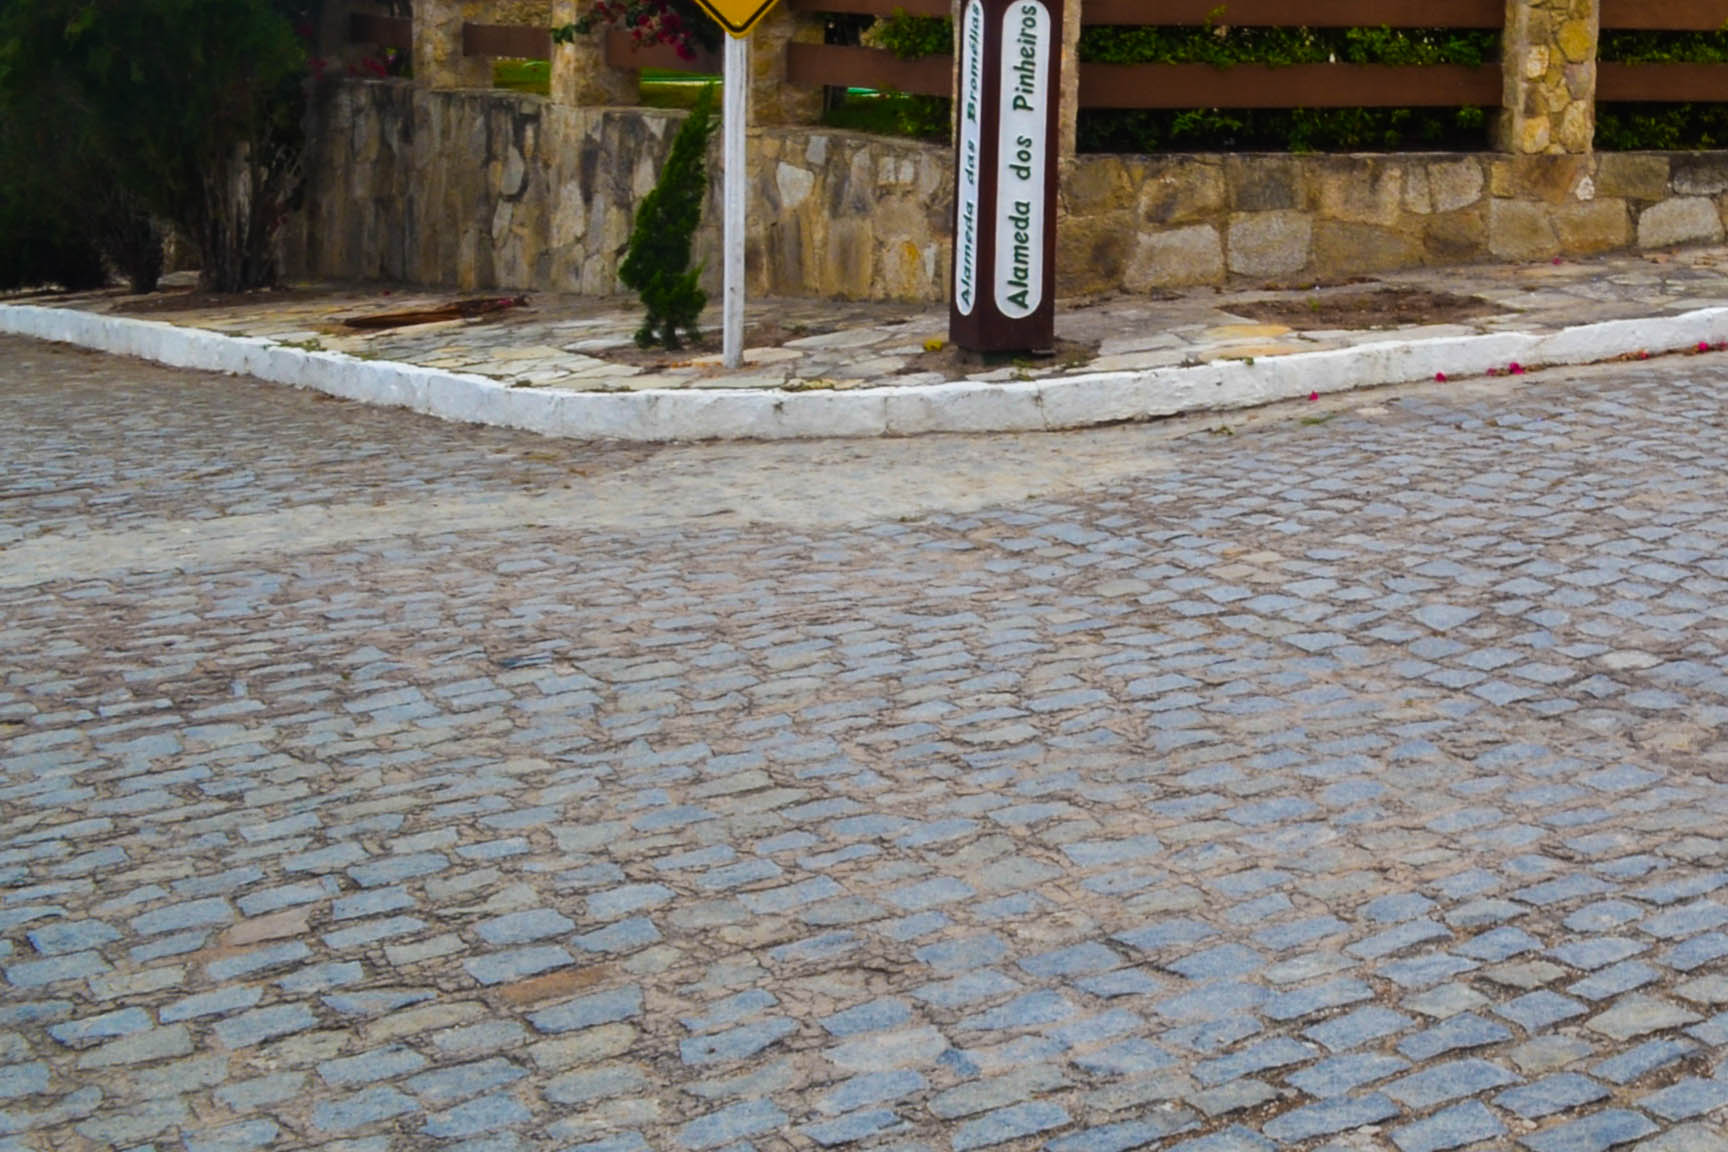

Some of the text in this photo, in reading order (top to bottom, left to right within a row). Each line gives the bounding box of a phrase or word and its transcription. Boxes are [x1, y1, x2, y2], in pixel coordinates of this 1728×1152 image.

[960, 3, 981, 307] Alameda das Bromélias
[1007, 4, 1038, 310] Alameda dos Pinheiros
